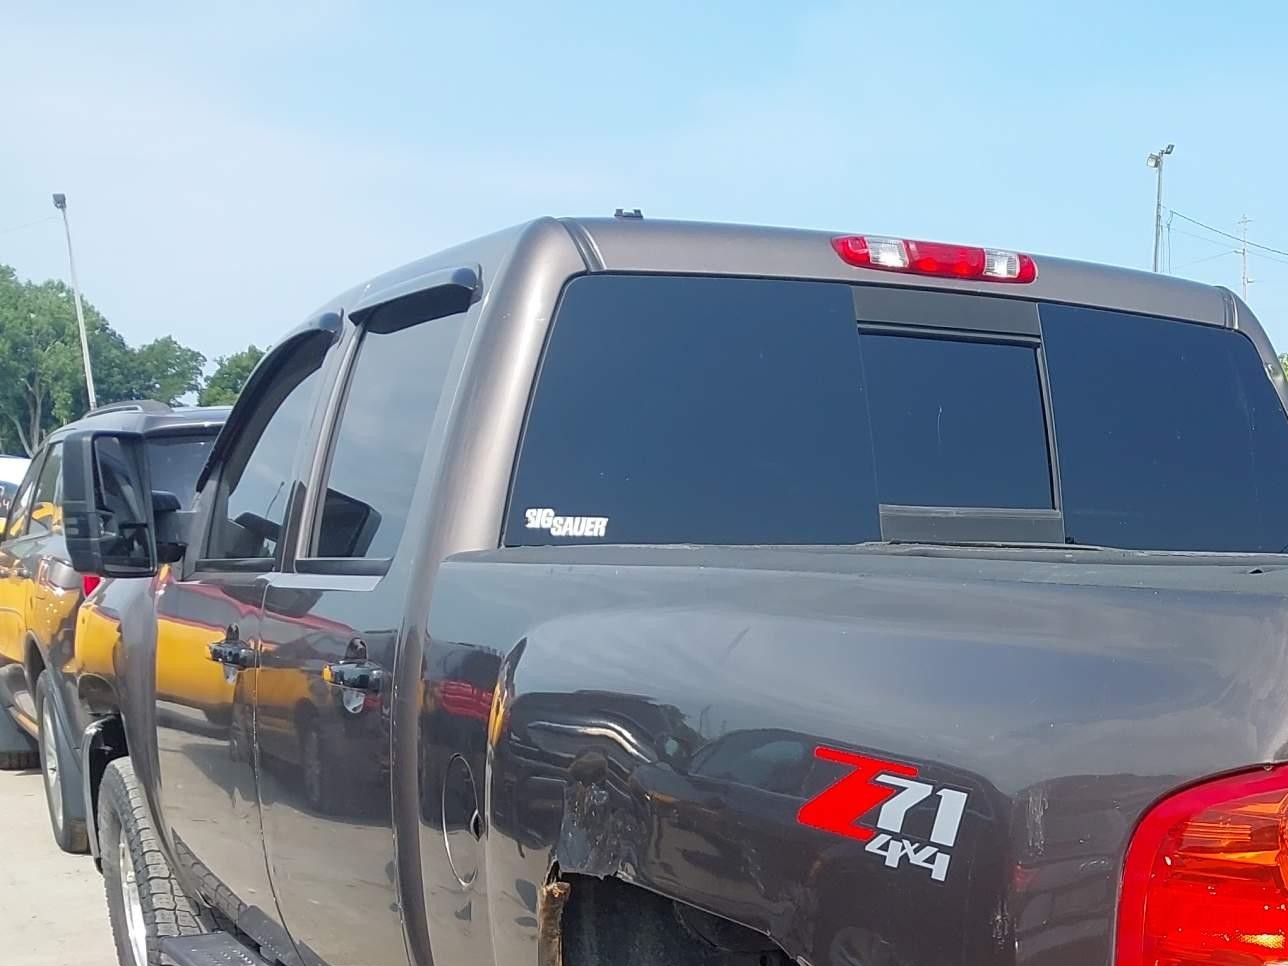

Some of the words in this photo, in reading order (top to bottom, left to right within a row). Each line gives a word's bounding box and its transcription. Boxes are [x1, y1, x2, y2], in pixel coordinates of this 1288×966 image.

[525, 508, 555, 528] SIG
[550, 516, 608, 537] SAUER
[796, 745, 968, 847] Z71
